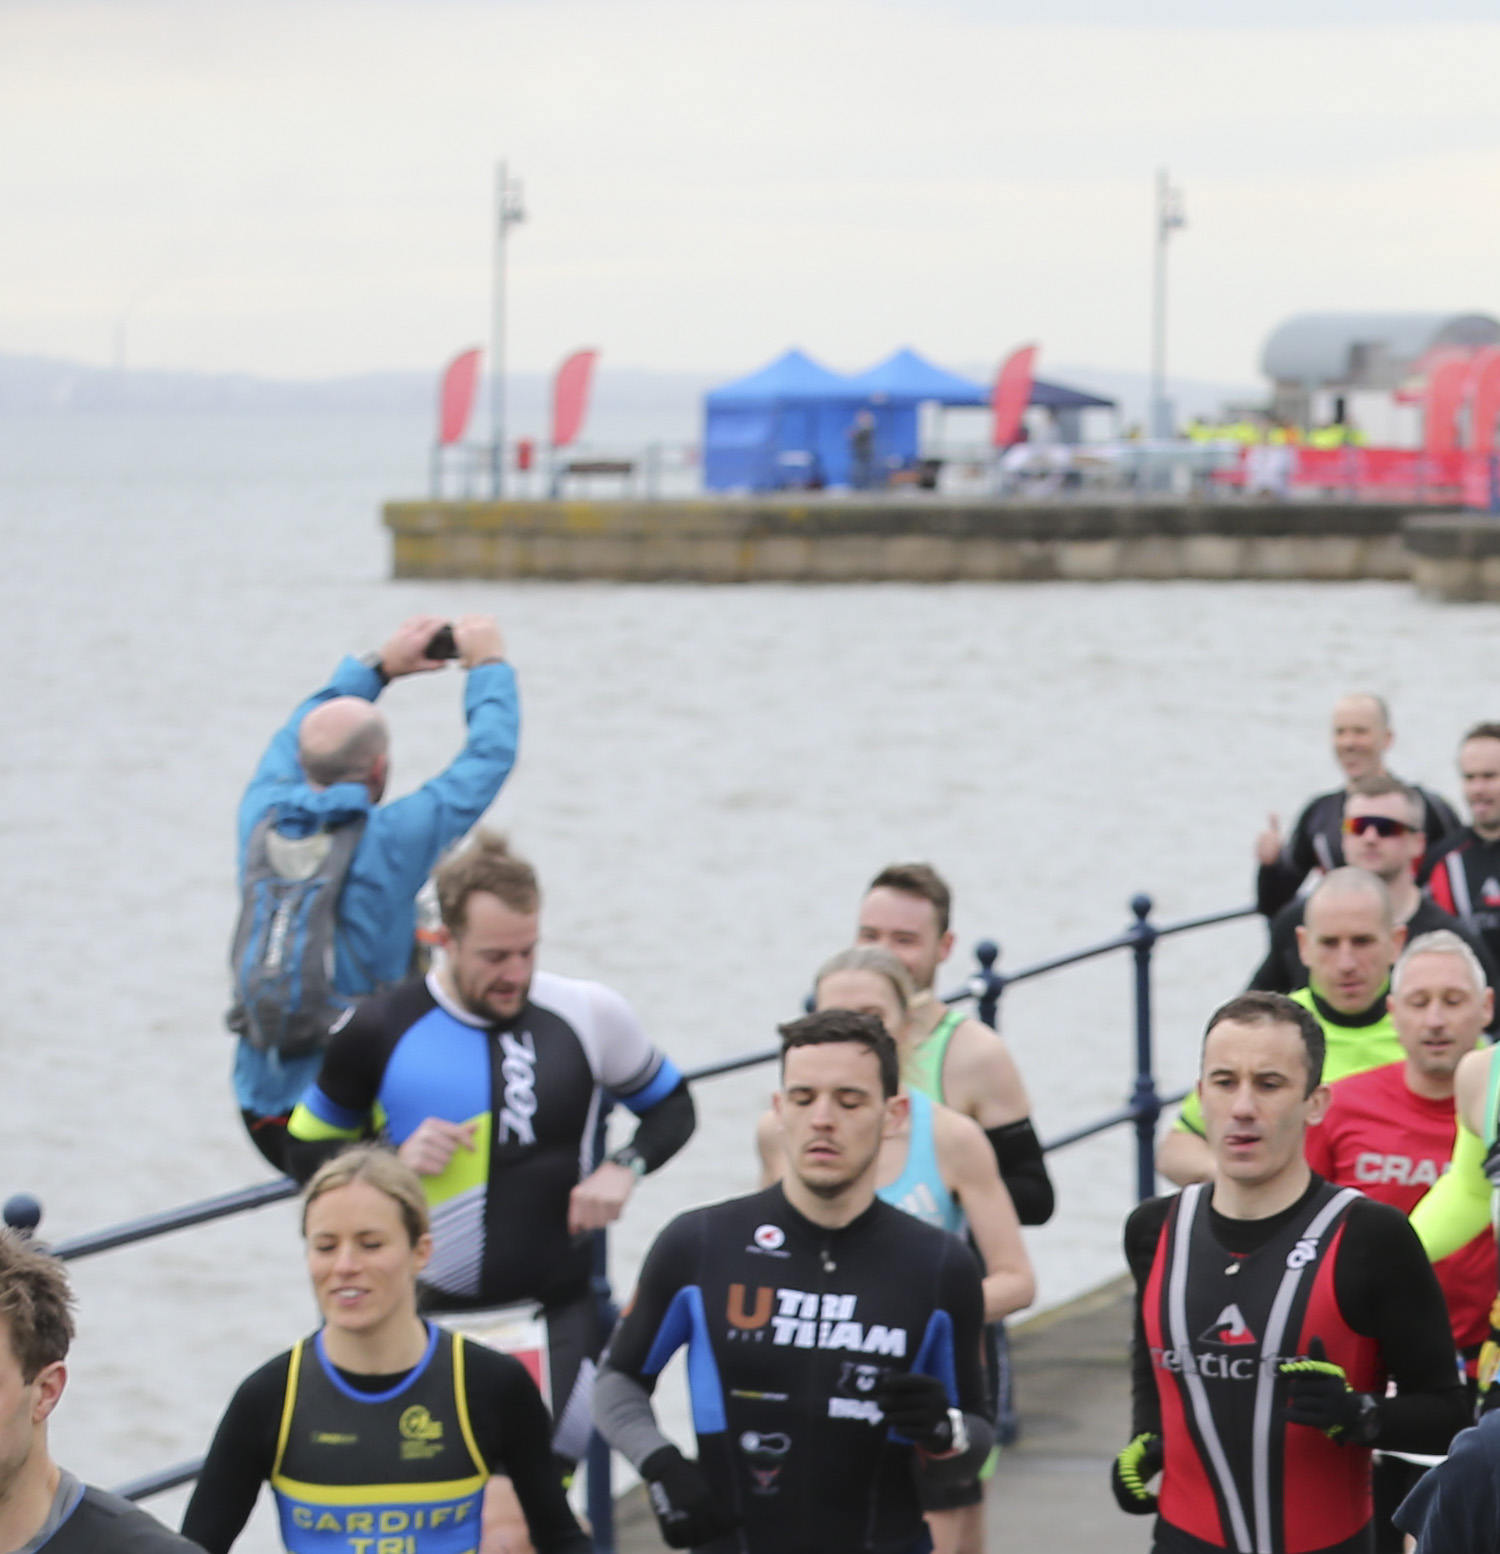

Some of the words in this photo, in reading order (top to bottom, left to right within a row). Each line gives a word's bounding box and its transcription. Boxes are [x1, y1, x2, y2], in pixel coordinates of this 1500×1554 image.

[1355, 1154, 1451, 1187] CRA
[726, 1284, 774, 1329] U
[771, 1318, 907, 1358] TEAM
[291, 1501, 475, 1534] CARDIFF
